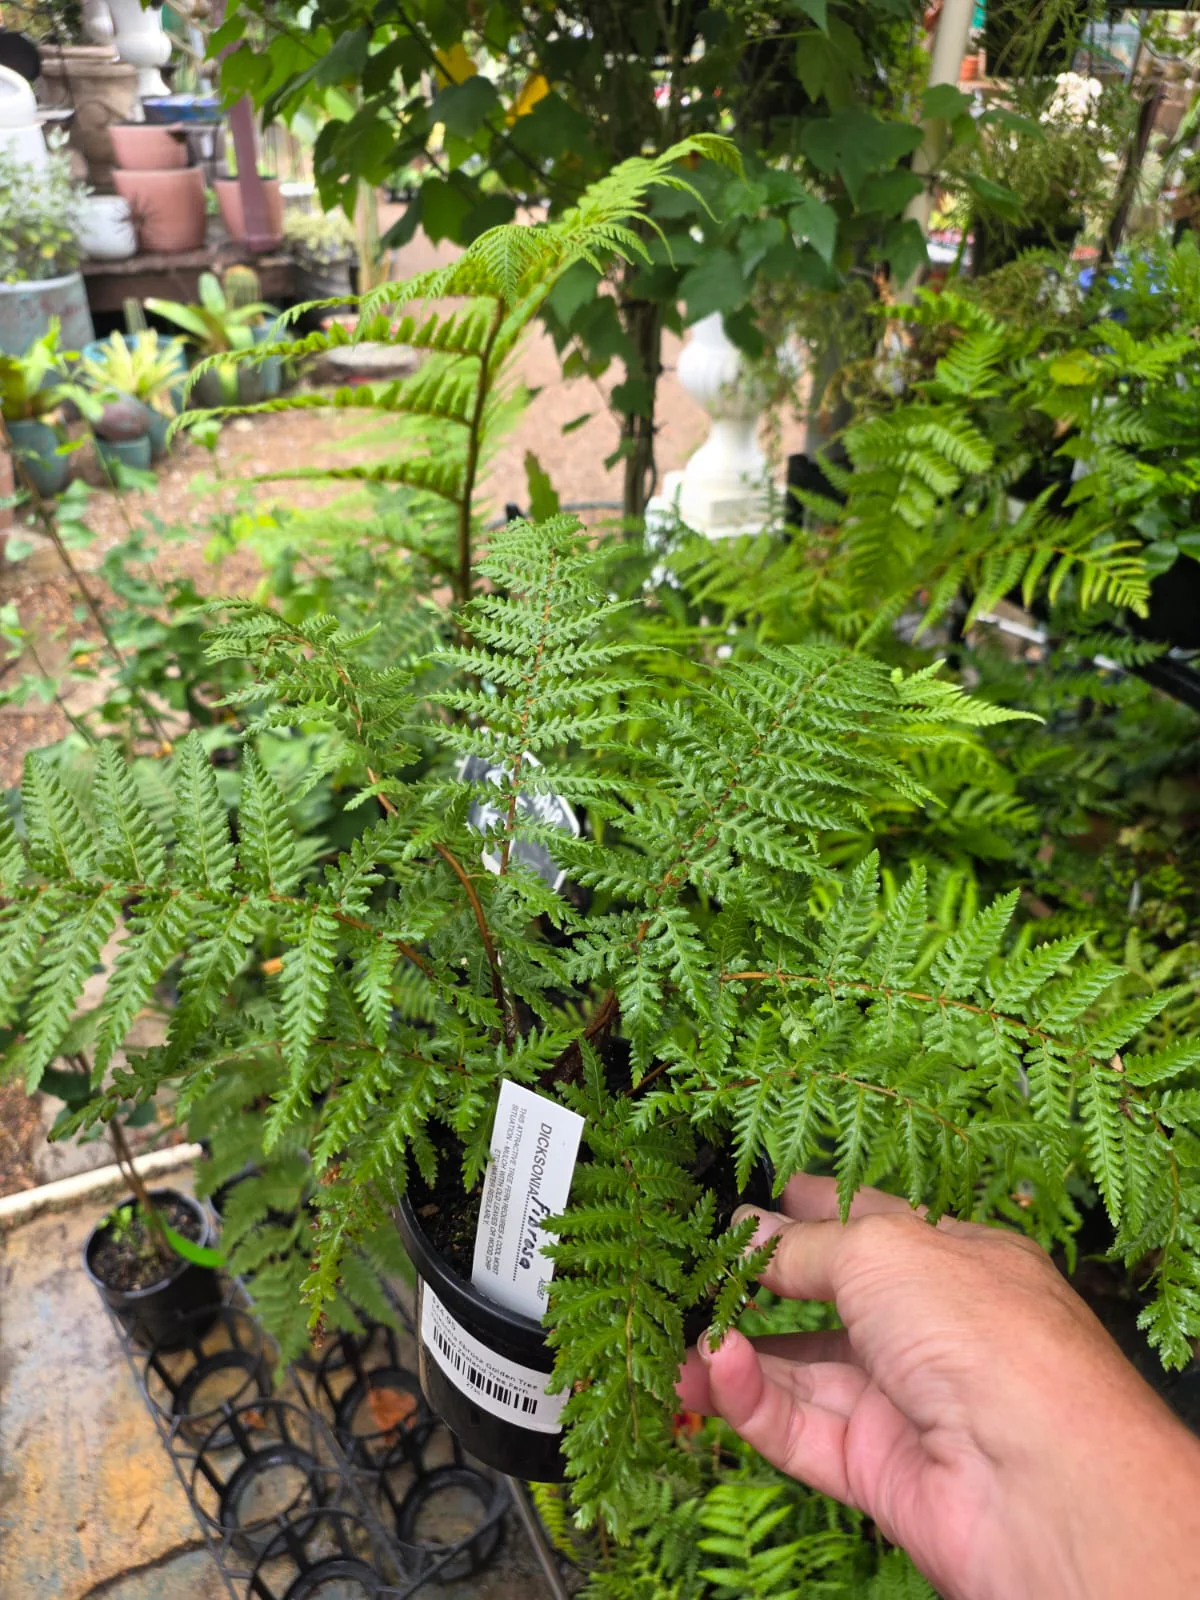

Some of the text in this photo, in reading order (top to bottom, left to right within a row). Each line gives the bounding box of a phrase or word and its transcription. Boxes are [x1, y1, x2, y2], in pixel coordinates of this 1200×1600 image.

[506, 1103, 519, 1142] SITUATION
[510, 1123, 523, 1167] ATTRACTIVE
[501, 1145, 510, 1170] MULCH
[527, 1122, 552, 1195] DICKSONIA
[488, 1164, 498, 1188] WATER
[498, 1169, 506, 1188] WITH
[507, 1166, 515, 1185] TREE
[495, 1186, 503, 1202] OLD
[503, 1184, 512, 1203] FERN
[491, 1201, 500, 1227] LEAVES
[498, 1202, 509, 1235] REQUIRES
[486, 1236, 495, 1256] WOOD
[495, 1239, 503, 1257] COOL
[492, 1257, 500, 1275] MOIST
[486, 1362, 516, 1383] Golden
[518, 1378, 538, 1390] Tree
[488, 1371, 506, 1385] Tree
[508, 1382, 528, 1395] Fern
